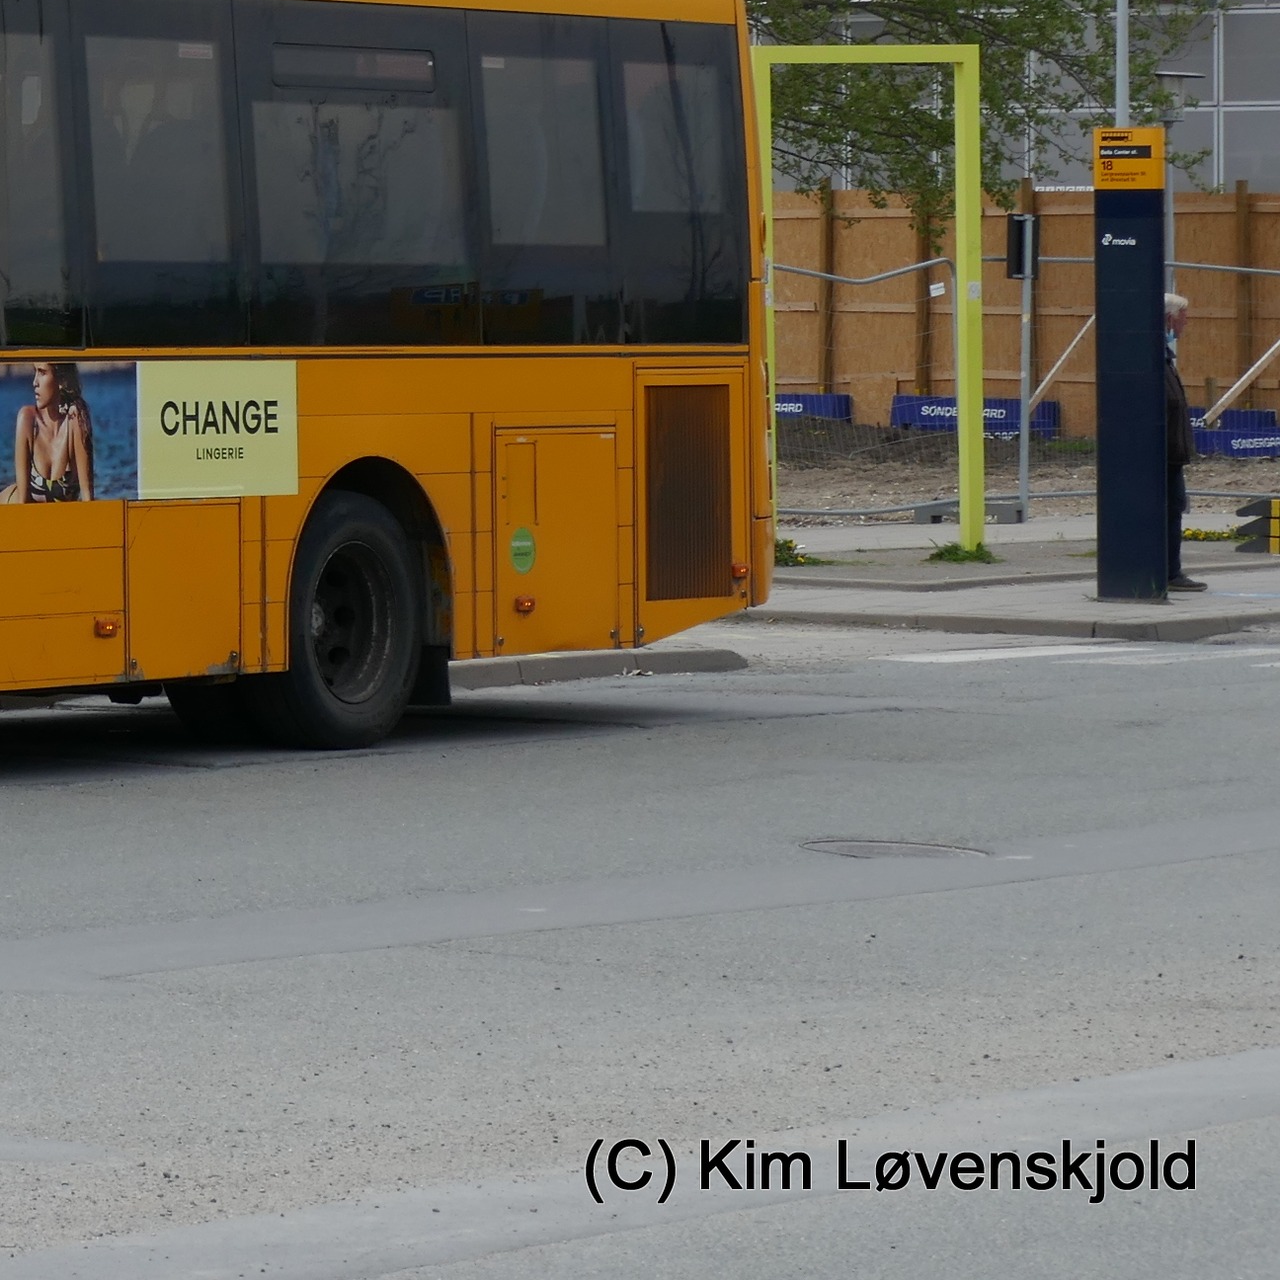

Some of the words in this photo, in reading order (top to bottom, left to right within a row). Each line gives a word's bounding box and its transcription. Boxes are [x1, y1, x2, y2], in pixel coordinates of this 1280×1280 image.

[1101, 160, 1113, 171] 18
[1112, 238, 1136, 246] movia
[160, 400, 279, 436] CHANGE
[196, 447, 244, 460] LINGERIE
